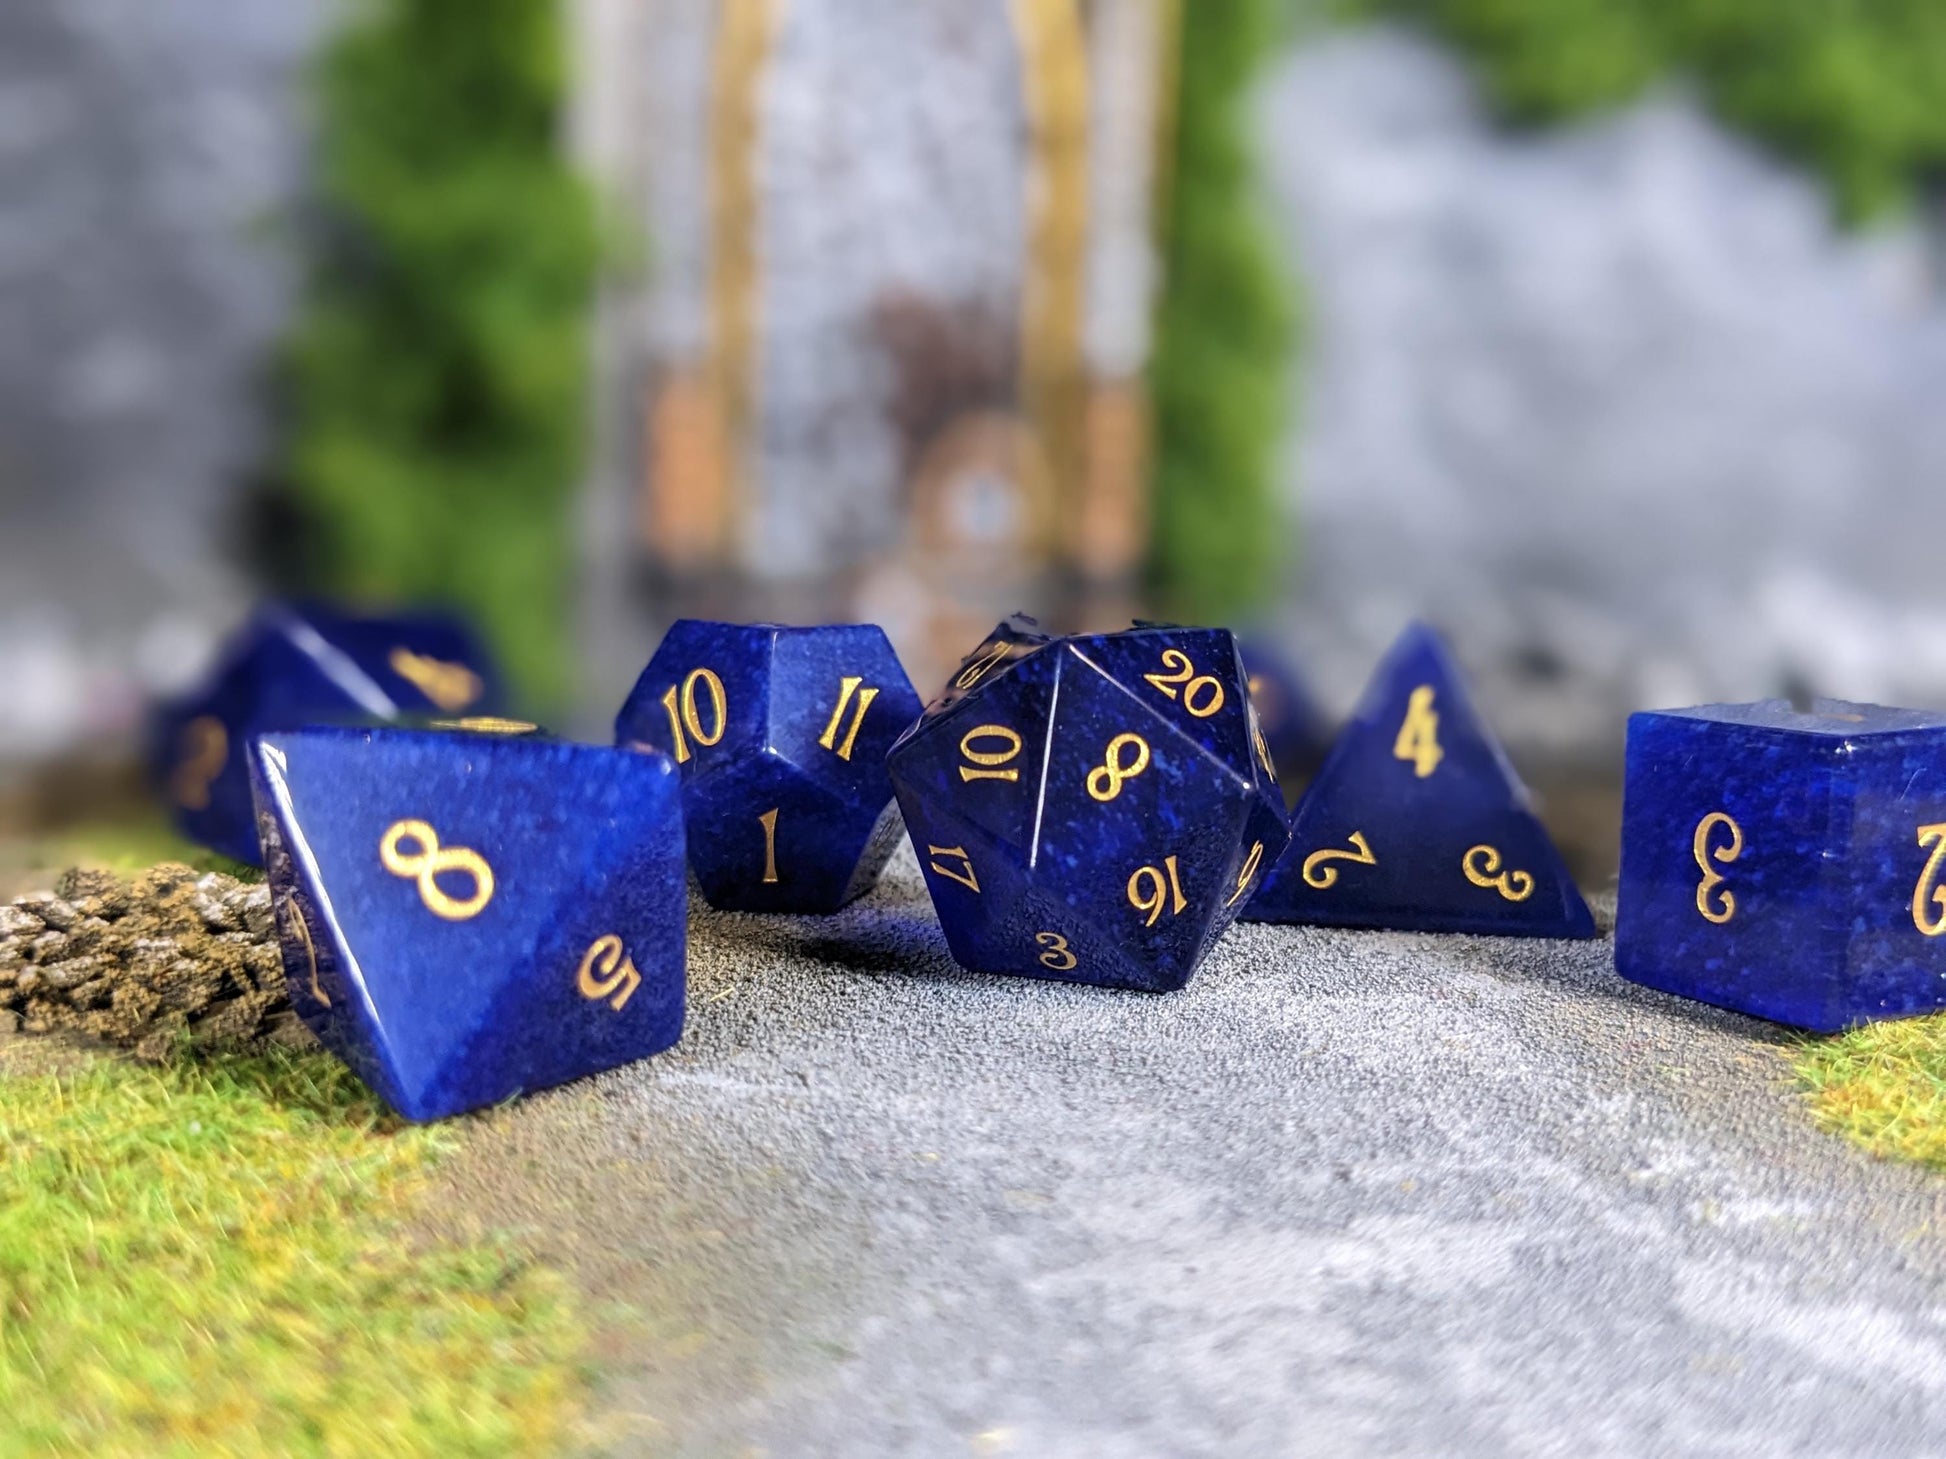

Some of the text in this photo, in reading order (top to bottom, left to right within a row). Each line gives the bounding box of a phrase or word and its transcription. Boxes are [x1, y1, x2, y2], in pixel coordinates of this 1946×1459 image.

[663, 668, 727, 764] 10
[819, 676, 879, 761] 11
[1144, 649, 1225, 718] 20
[959, 724, 1022, 782] 10
[1393, 684, 1444, 777] 4
[1086, 732, 1151, 802] 8
[381, 820, 494, 920] 8
[758, 808, 779, 883] 1
[928, 845, 980, 894] 17
[1302, 831, 1376, 889] 2
[1462, 844, 1535, 902] 3
[1693, 812, 1742, 924] 3
[1127, 855, 1188, 927] 16
[577, 934, 642, 1011] 5
[1035, 932, 1078, 970] 3
